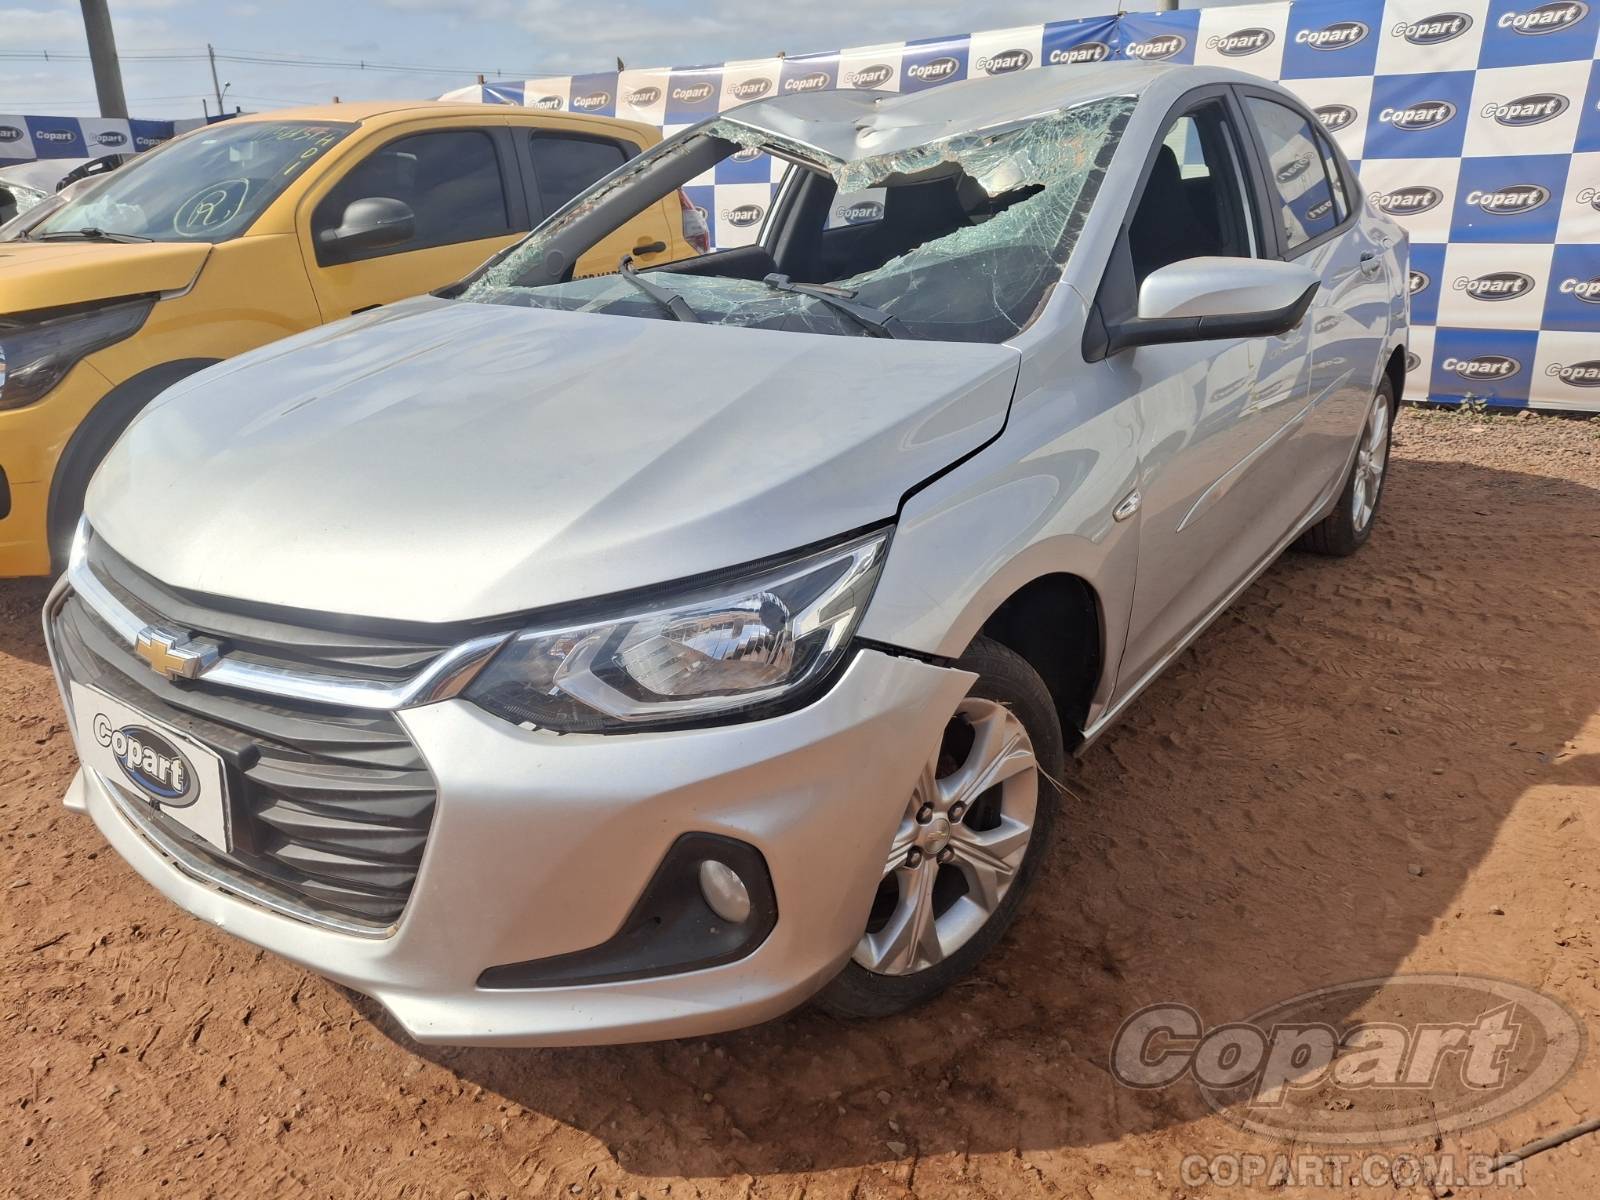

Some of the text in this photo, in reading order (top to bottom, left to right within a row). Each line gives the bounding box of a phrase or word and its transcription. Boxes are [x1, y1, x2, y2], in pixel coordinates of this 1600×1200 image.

[1498, 6, 1576, 29] Copart
[1295, 26, 1361, 45] Copart
[1391, 19, 1460, 39] Copart
[1126, 40, 1177, 57] Copart
[1206, 33, 1265, 52] Copart
[1050, 44, 1102, 63] Copart
[907, 60, 953, 78] Copart
[976, 54, 1026, 72] Copart
[785, 75, 826, 91] Copart
[844, 68, 888, 85] Copart
[673, 84, 710, 100] Copart
[728, 80, 766, 96] Copart
[574, 93, 607, 108] Copart
[1481, 99, 1557, 119] Copart
[1320, 107, 1348, 124] art
[1380, 105, 1446, 124] Copart
[36, 131, 73, 141] Copart
[136, 137, 161, 146] Copa
[1368, 190, 1432, 209] Copart
[1466, 190, 1538, 209] Copart
[721, 208, 759, 222] Copart
[836, 204, 878, 219] Copart
[1453, 275, 1526, 295] Copart
[1559, 279, 1600, 297] Cop
[1442, 357, 1511, 375] Copart
[1545, 363, 1600, 381] Copa
[93, 713, 184, 794] Copart
